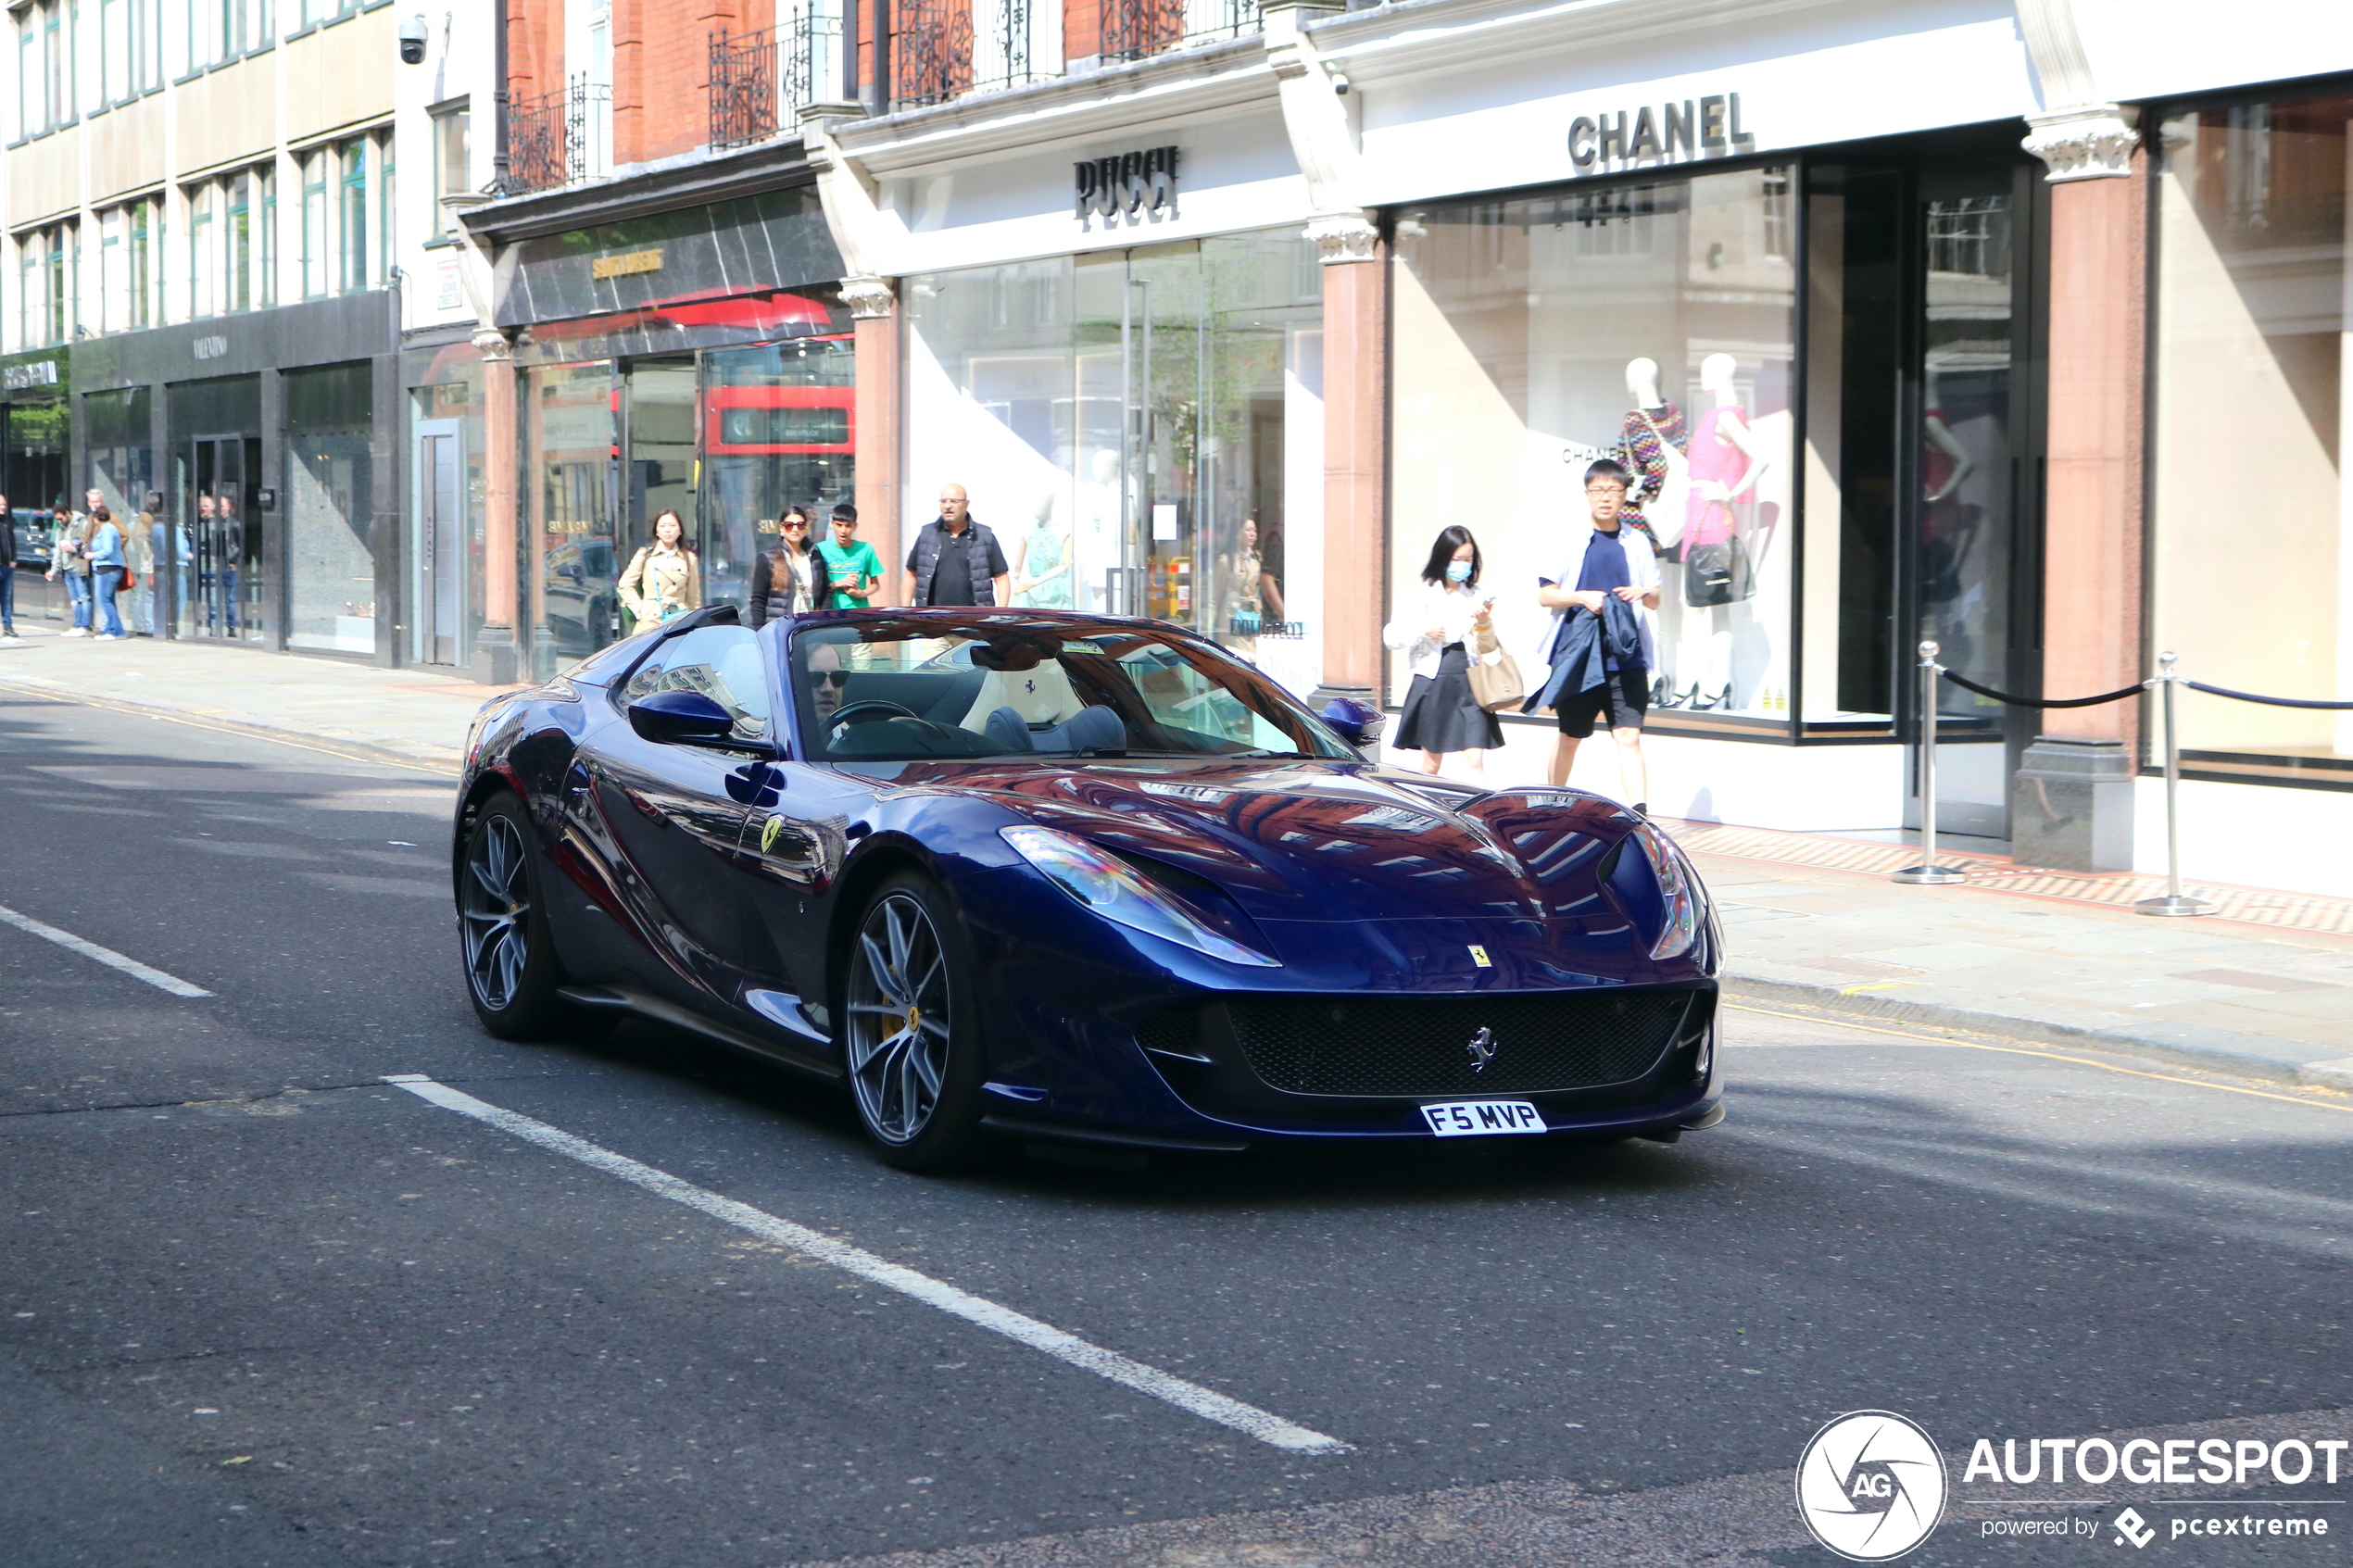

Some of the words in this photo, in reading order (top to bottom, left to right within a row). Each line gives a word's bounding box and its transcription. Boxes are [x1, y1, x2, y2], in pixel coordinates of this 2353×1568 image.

[1568, 93, 1755, 167] CHANEL
[1073, 145, 1178, 220] PUCCI
[1562, 447, 1617, 464] CHANE
[1426, 1107, 1474, 1132] F5
[1475, 1105, 1536, 1129] MVP
